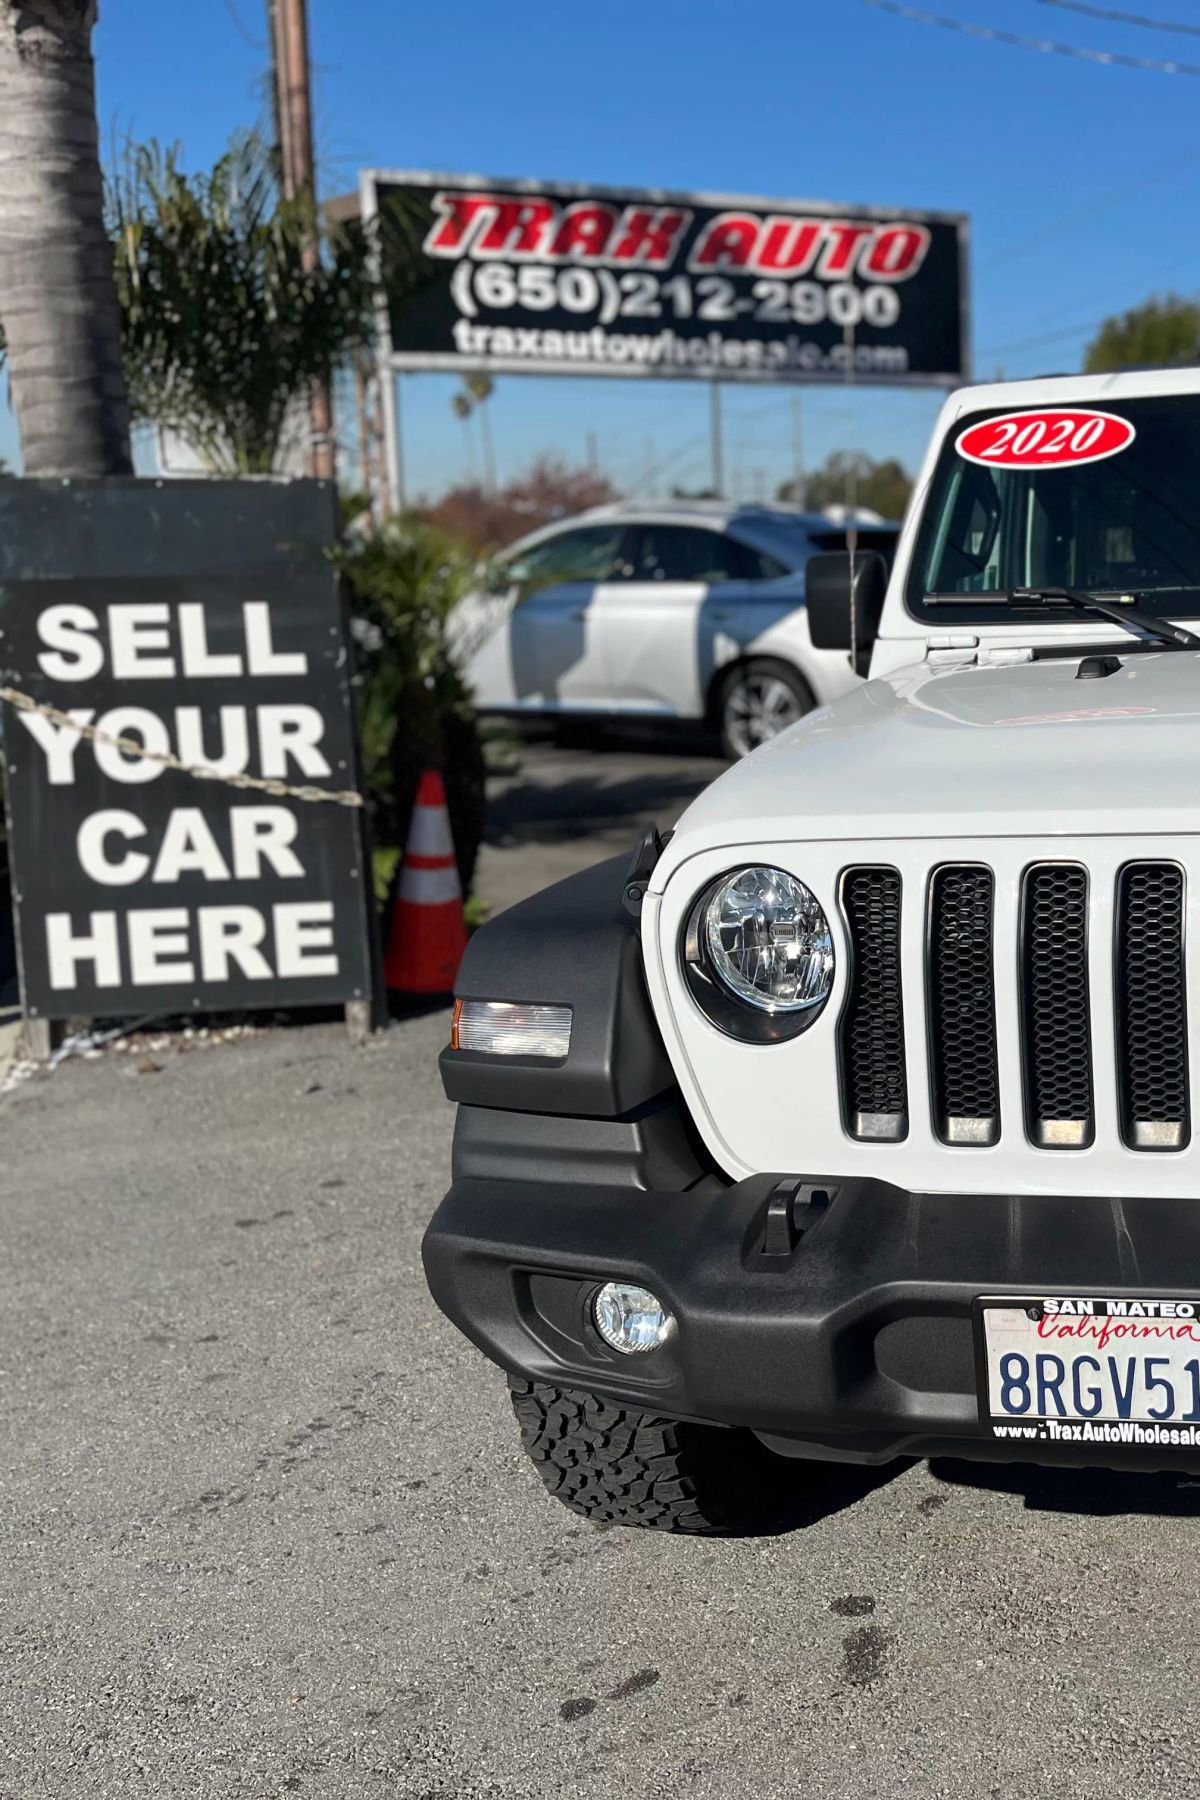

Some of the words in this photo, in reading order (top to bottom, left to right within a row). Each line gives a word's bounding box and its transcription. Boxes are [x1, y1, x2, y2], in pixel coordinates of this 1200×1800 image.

[423, 192, 694, 269] TRAX
[686, 212, 931, 283] AUTO
[451, 260, 900, 327] (650)212-2900
[979, 418, 1106, 457] 2020
[37, 602, 308, 682] SELL
[17, 704, 332, 784] YOUR
[77, 806, 306, 886] CAR
[45, 901, 339, 990] HERE
[1043, 1300, 1094, 1315] SAN
[1106, 1301, 1195, 1318] MATEO
